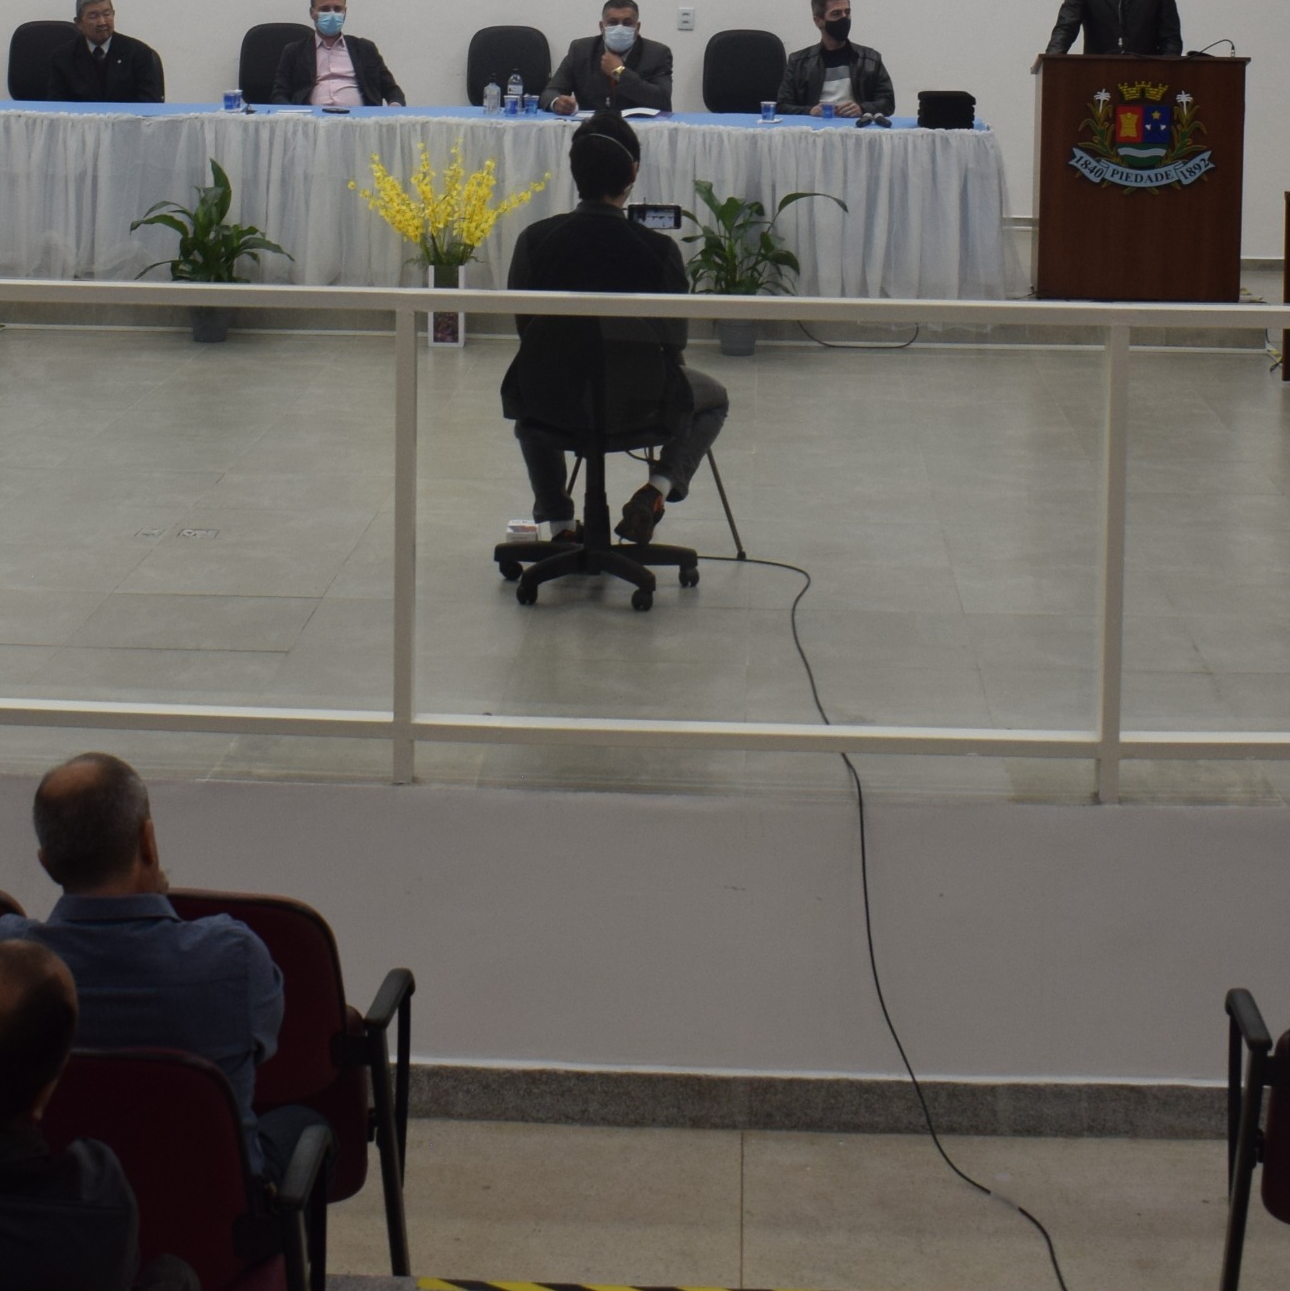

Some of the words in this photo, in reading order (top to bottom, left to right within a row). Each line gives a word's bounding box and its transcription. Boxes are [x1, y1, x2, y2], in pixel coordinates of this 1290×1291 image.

[1075, 155, 1105, 179] 1840
[1110, 168, 1175, 184] PIEDADE
[1178, 157, 1210, 181] 1892
